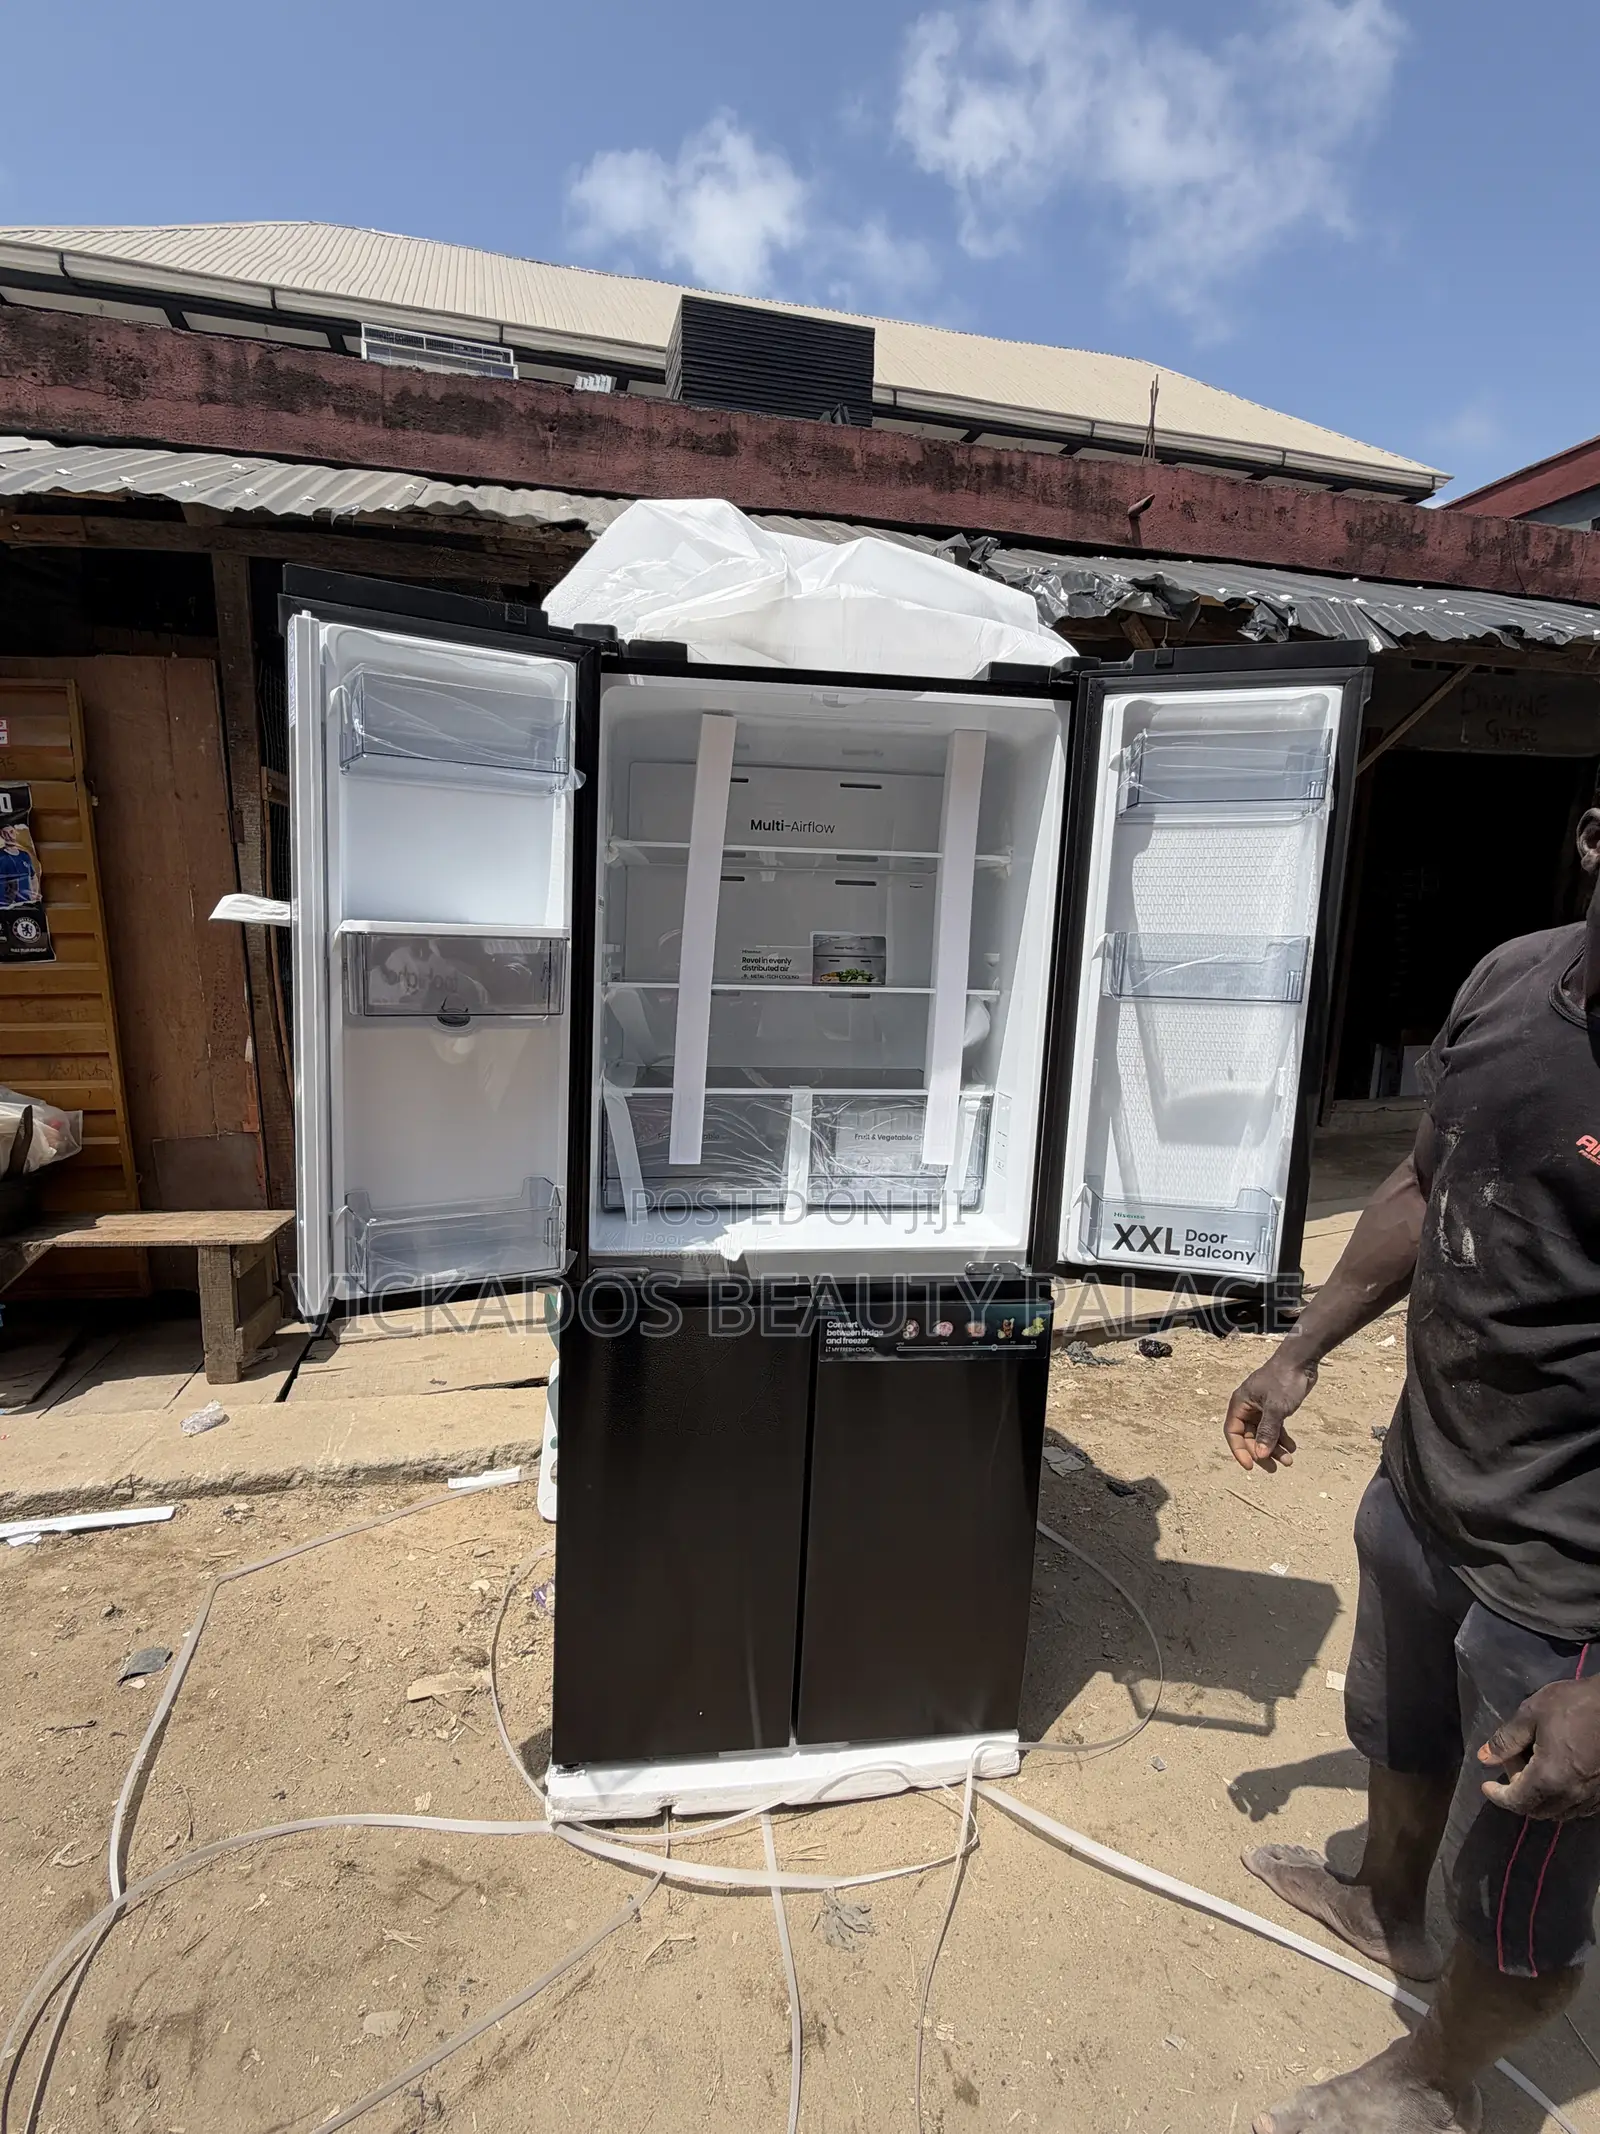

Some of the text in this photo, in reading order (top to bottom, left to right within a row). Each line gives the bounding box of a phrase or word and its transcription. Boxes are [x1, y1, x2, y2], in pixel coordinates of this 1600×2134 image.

[750, 819, 836, 834] Multi-Airflow
[769, 957, 792, 966] evenly
[877, 1134, 913, 1142] Vegetable
[1112, 1223, 1180, 1256] XXL
[1185, 1229, 1228, 1245] Door
[1184, 1244, 1257, 1265] Balcony
[826, 1329, 884, 1338] between fridge
